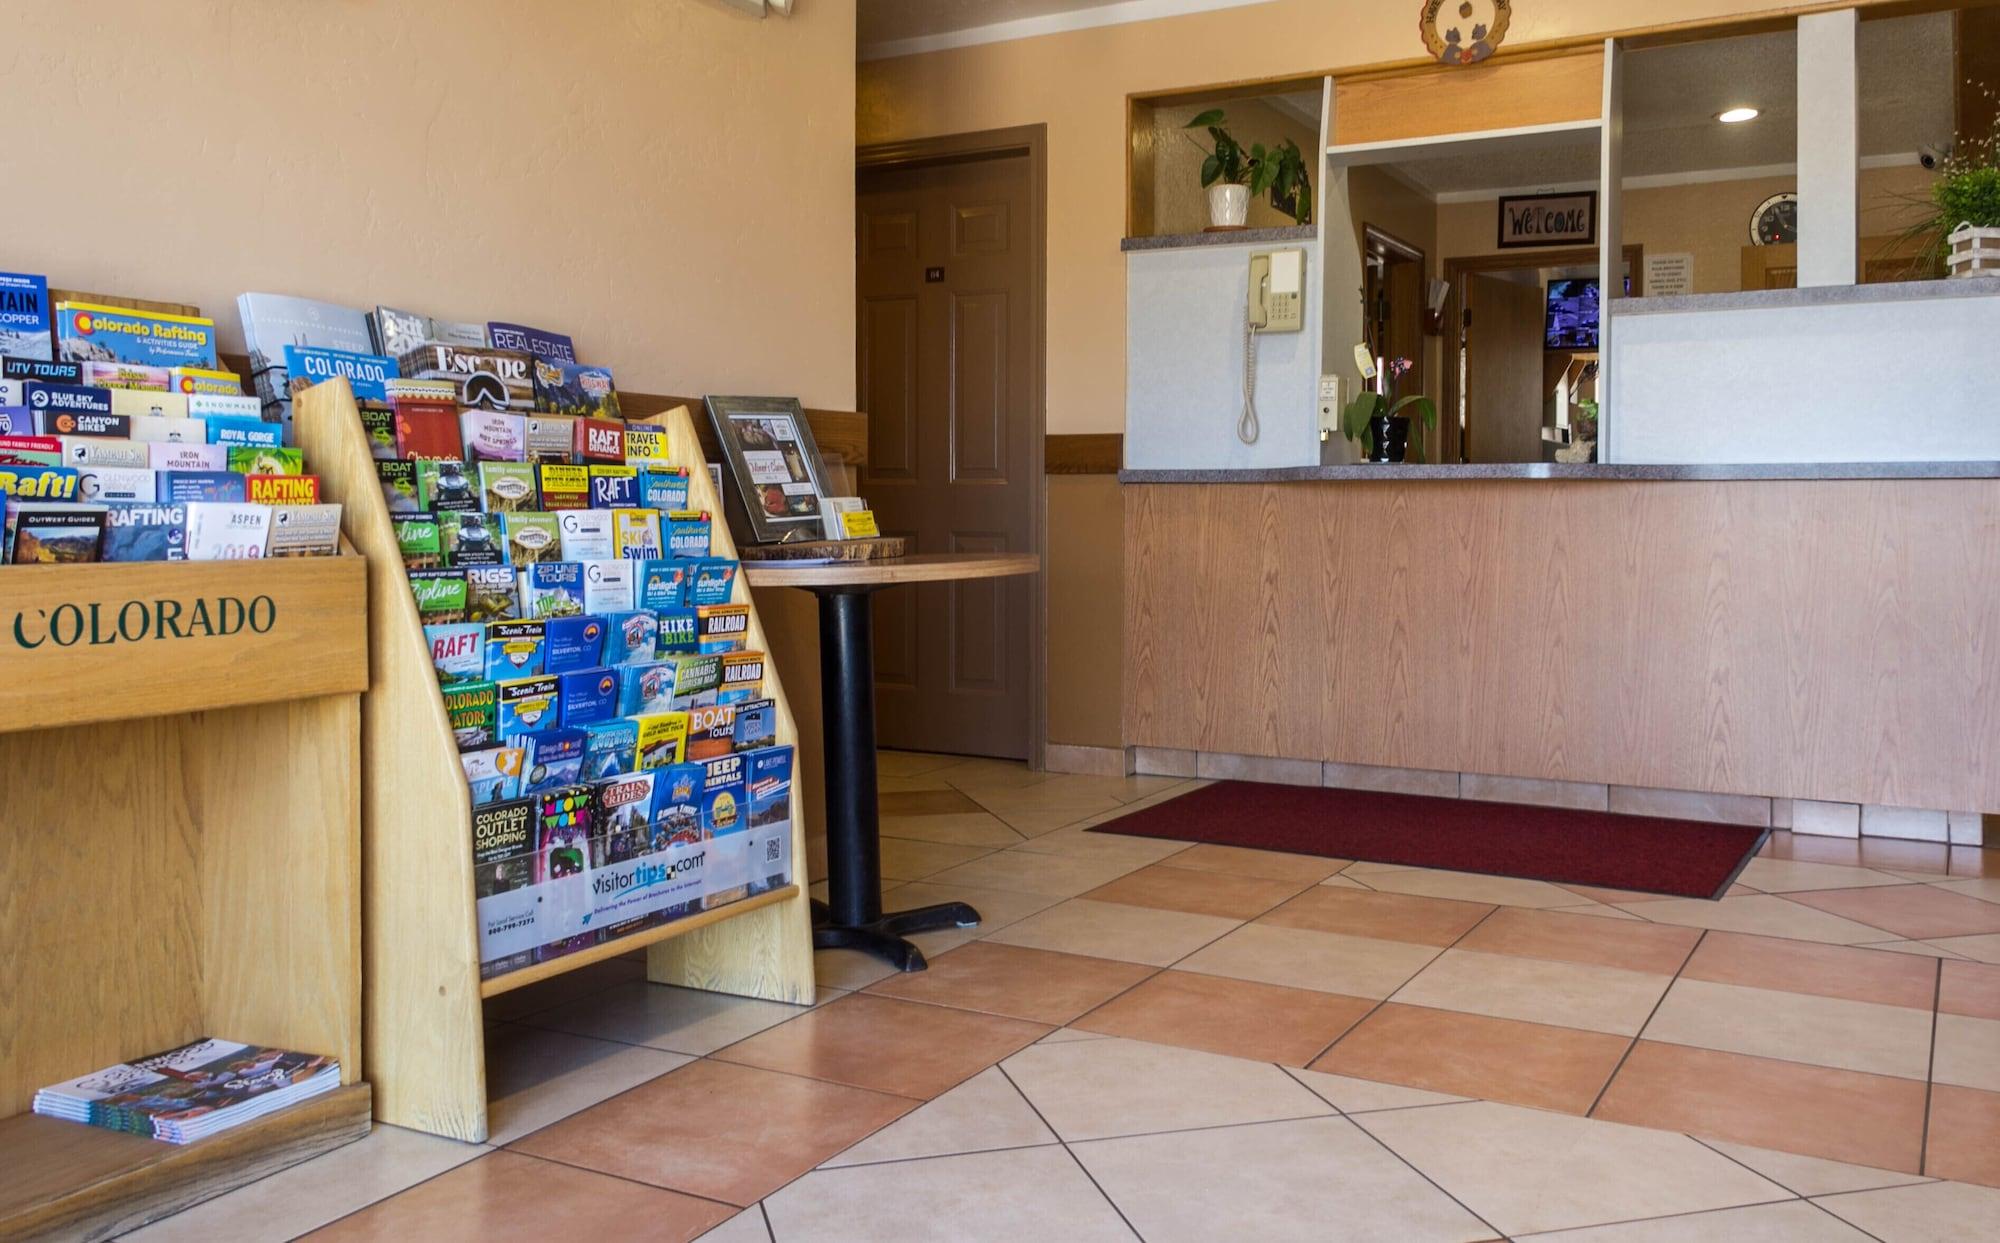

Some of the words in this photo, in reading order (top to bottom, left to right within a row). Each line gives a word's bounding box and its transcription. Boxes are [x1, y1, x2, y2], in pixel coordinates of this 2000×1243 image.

[1509, 206, 1585, 236] WELCOME
[73, 311, 150, 337] Colorado
[152, 322, 207, 347] Rafting
[7, 362, 31, 376] UTV
[34, 364, 77, 380] TOURS
[305, 356, 386, 384] COLORADO
[180, 376, 240, 397] Colorado
[52, 391, 76, 402] BLUE
[76, 395, 94, 404] SKY
[51, 400, 109, 413] ADVENTURES
[206, 400, 258, 411] SNOWMASS
[78, 415, 120, 427] CANYON
[362, 411, 392, 421] BOAT
[78, 423, 106, 433] BIKES
[221, 429, 247, 440] ROYAL
[247, 431, 274, 443] GORGE
[589, 427, 621, 446] RAFT
[626, 432, 660, 445] TRAVEL
[12, 441, 30, 449] FAMILY
[31, 442, 54, 450] FRIENDLY
[627, 445, 651, 457] INFO
[180, 452, 199, 460] IRON
[167, 460, 210, 469] MOUNTAIN
[382, 462, 412, 472] BOAT
[252, 478, 314, 499] RAFTING
[595, 477, 634, 503] RAFT
[647, 476, 688, 489] Southwest
[647, 488, 687, 503] COLORADO
[105, 508, 183, 527] RAFTING
[231, 513, 262, 524] ASPEN
[622, 530, 642, 545] SKI
[671, 524, 710, 536] Southwest
[670, 535, 709, 549] COLORADO
[467, 567, 514, 585] RIGS
[537, 565, 554, 575] ZIP
[554, 564, 579, 575] LINE
[539, 573, 577, 584] TOURS
[14, 595, 277, 649] COLORADO
[659, 618, 694, 634] HIKE
[708, 615, 746, 635] RAILROAD
[498, 625, 523, 636] Scenic
[523, 624, 542, 634] Train
[433, 632, 480, 660] RAFT
[665, 631, 695, 646] BIKE
[681, 663, 717, 677] CANNABIS
[725, 663, 762, 683] RAILROAD
[677, 676, 704, 690] TOURISM
[703, 673, 717, 685] MAP
[508, 686, 535, 697] Scenic
[535, 682, 555, 693] Train
[744, 701, 770, 712] ATTRACTION
[694, 707, 736, 731] BOAT
[709, 724, 737, 739] Tours
[707, 757, 742, 778] JEEP
[705, 771, 742, 788] RENTALS
[609, 781, 646, 797] TRAIN
[608, 789, 646, 806] RIDES
[475, 806, 529, 825] COLORADO
[476, 816, 527, 838] OUTLET
[475, 831, 527, 850] SHOPPING
[594, 903, 618, 914] Delivering
[508, 913, 527, 922] Service
